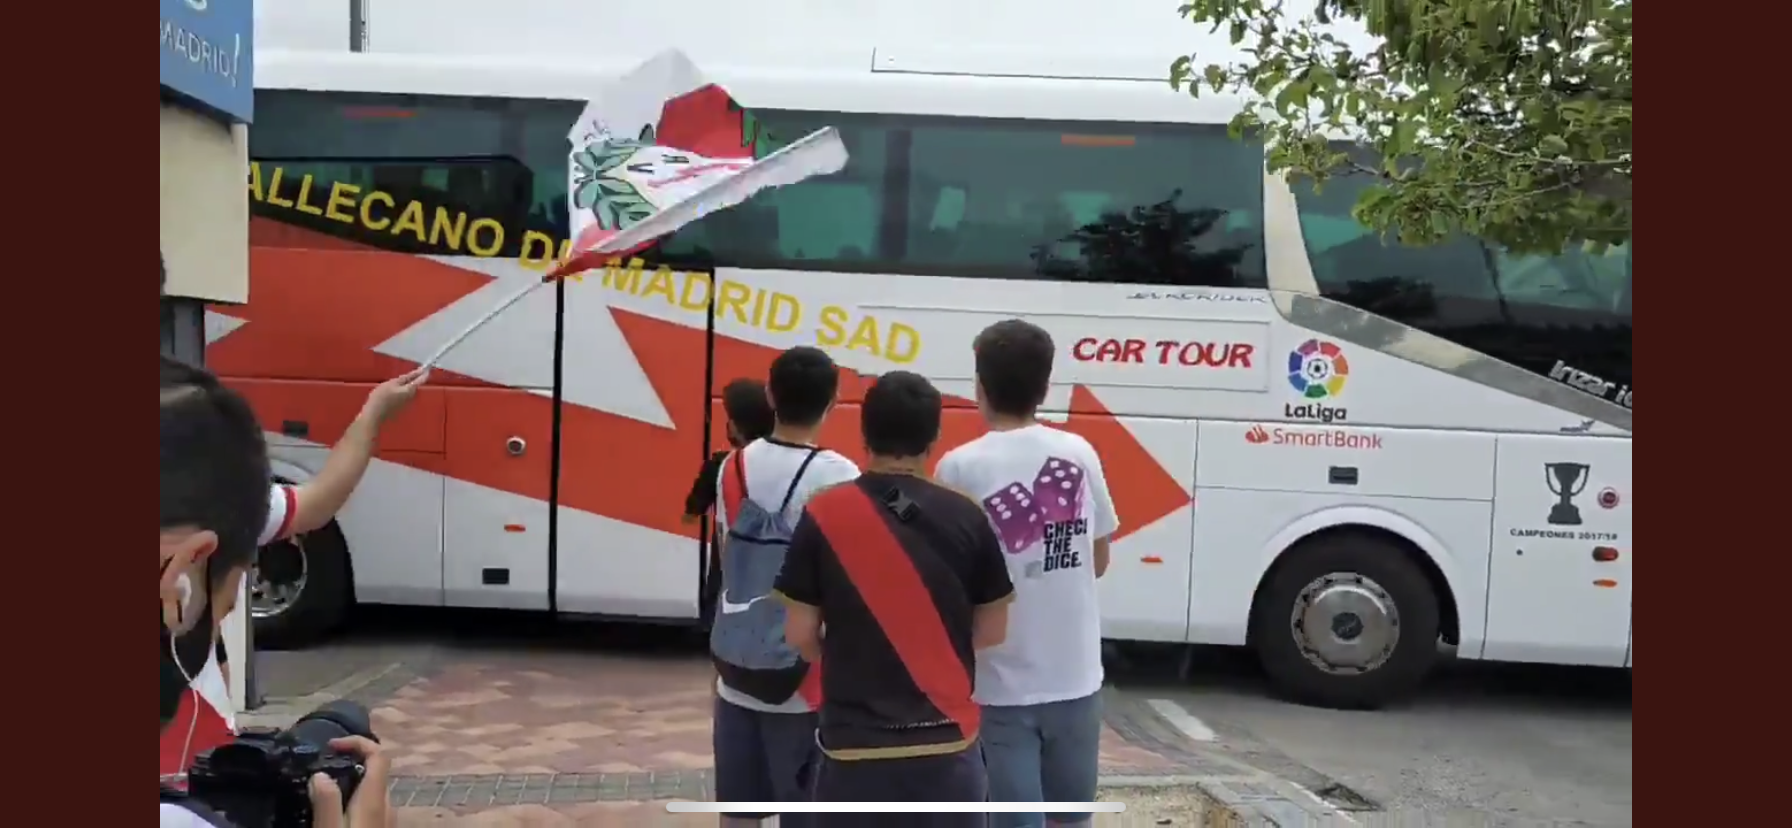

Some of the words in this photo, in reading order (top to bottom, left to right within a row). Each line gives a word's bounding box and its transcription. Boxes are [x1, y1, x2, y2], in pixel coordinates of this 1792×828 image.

[601, 255, 802, 333] MADRID
[815, 305, 921, 364] SAD
[1073, 337, 1146, 365] CAR
[1155, 340, 1254, 368] TOUR
[1284, 403, 1347, 423] LaLiga
[1272, 427, 1383, 450] SmartBank
[1509, 528, 1575, 540] CAMPEONES
[1043, 536, 1072, 555] THE
